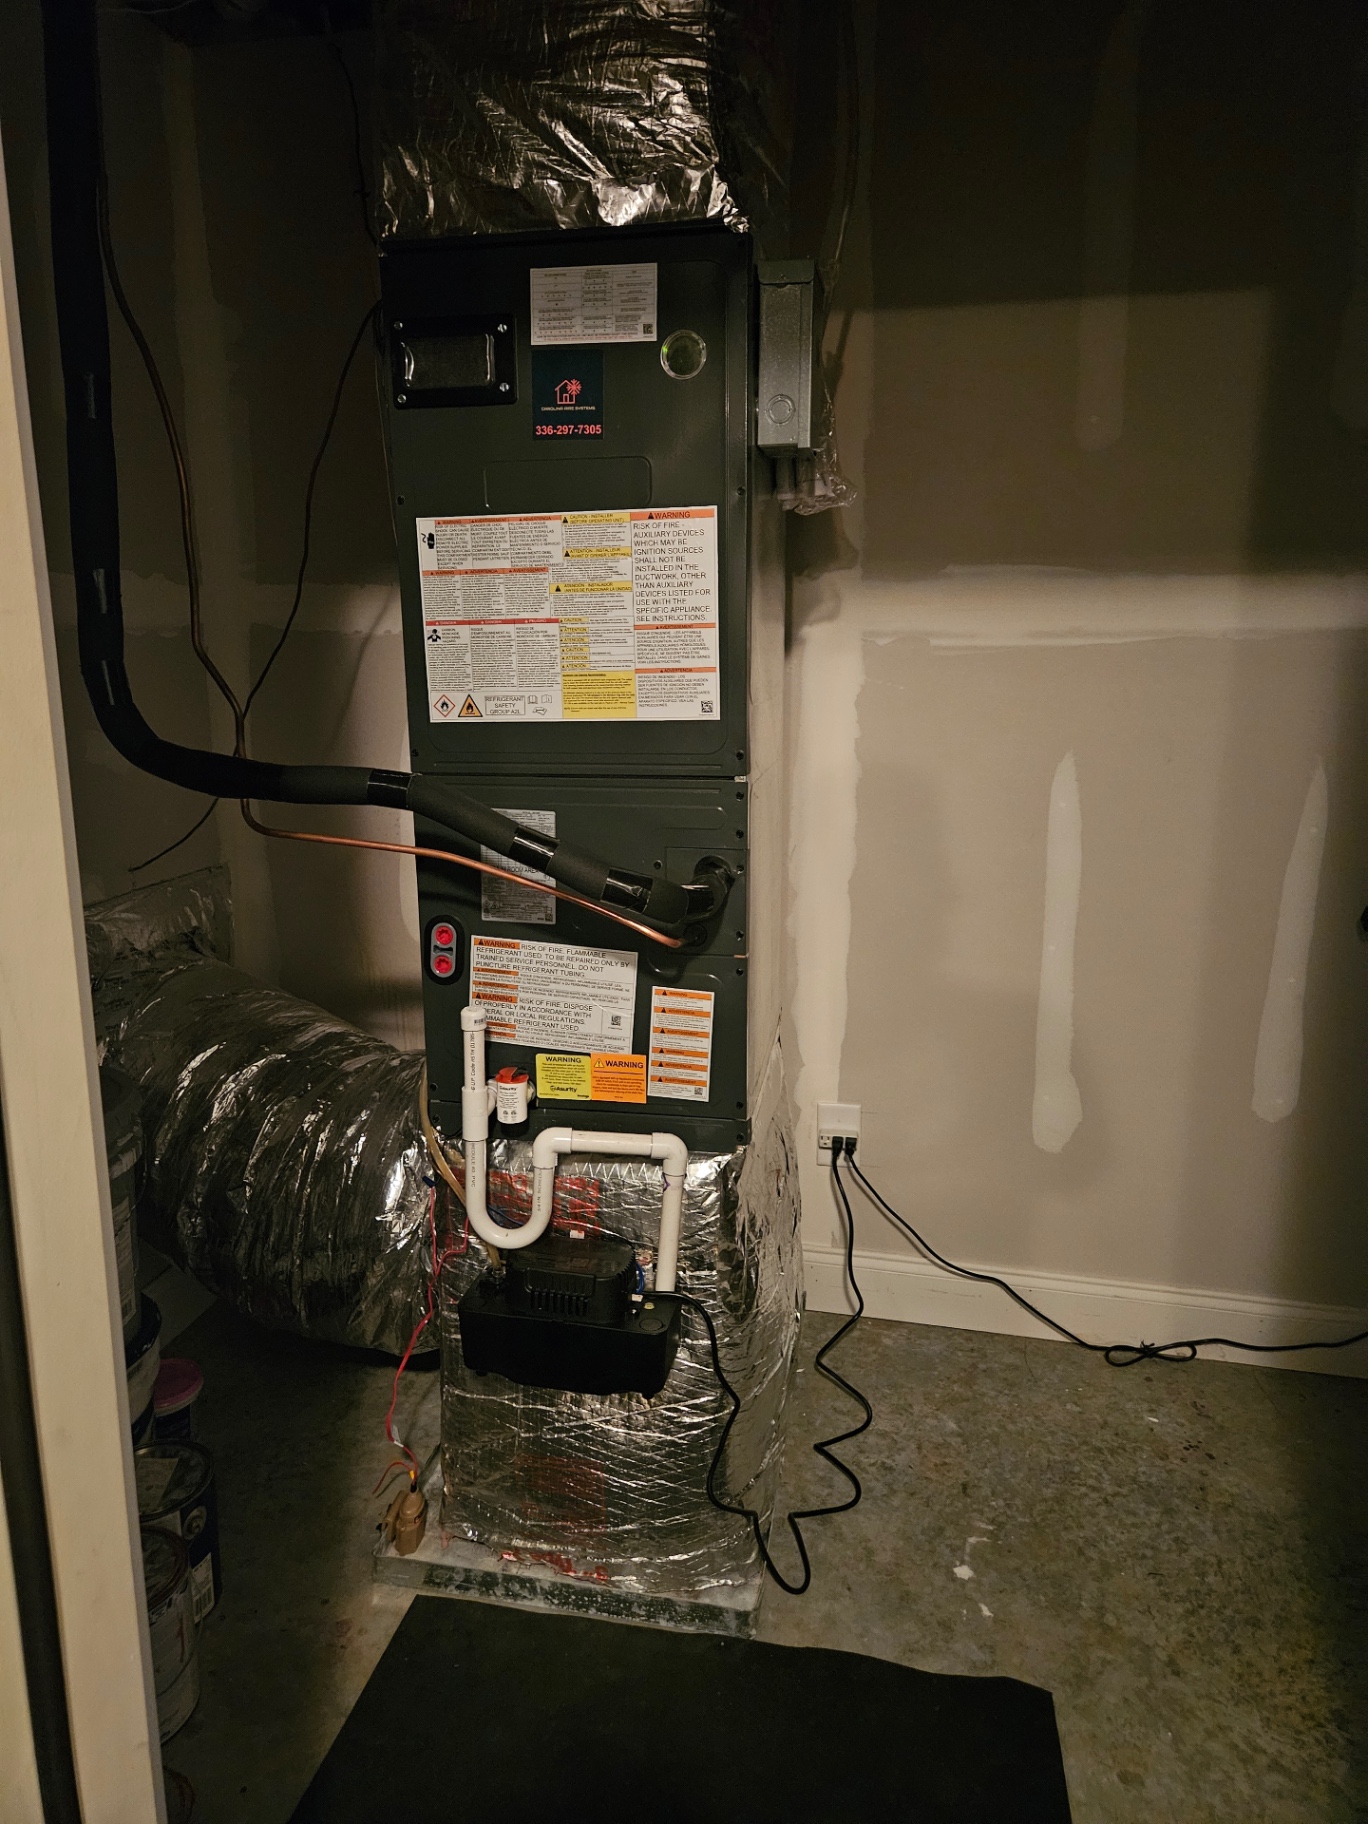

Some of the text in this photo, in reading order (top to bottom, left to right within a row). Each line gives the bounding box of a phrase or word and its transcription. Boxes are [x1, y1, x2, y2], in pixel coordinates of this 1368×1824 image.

[536, 424, 602, 435] 336-297-7305
[655, 511, 690, 519] WARNING
[634, 529, 704, 538] AUXILIARY DEVICES
[635, 564, 673, 572] INSTALLED
[484, 940, 515, 948] WARNING
[567, 949, 606, 958] FLAMMABLE
[476, 947, 522, 956] REFRIGERANT
[567, 956, 600, 964] REPAIRED
[506, 957, 534, 965] SERVICE
[476, 961, 511, 969] PUNCTURE
[513, 964, 558, 974] REFRIGERANT
[481, 993, 512, 1002] WARNING
[564, 1003, 593, 1011] DISPOSE
[527, 1006, 572, 1016] ACCORDANCE
[514, 1019, 559, 1028] REFRIGERANT
[606, 1060, 644, 1068] WARNING
